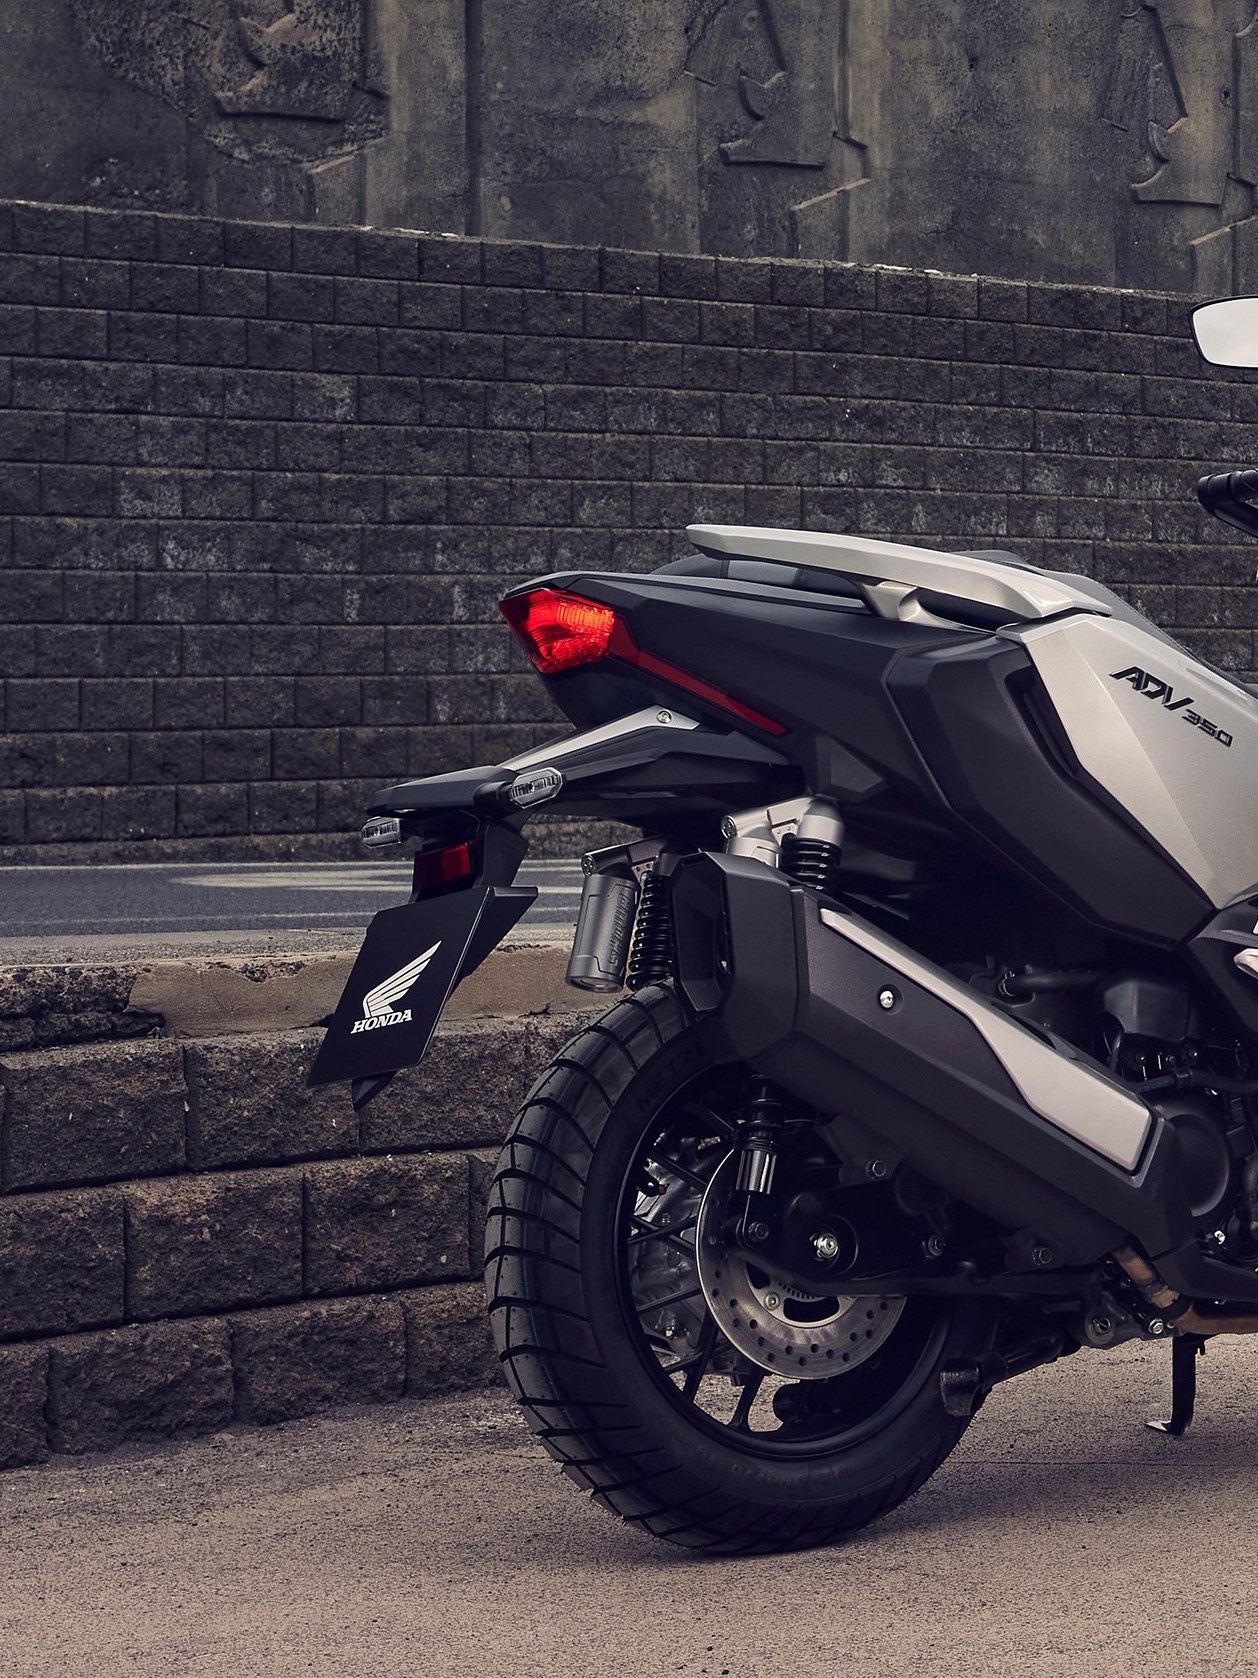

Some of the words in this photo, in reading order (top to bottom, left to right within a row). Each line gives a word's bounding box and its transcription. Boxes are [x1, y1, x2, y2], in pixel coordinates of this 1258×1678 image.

[1109, 665, 1194, 711] ADV
[1181, 708, 1233, 748] 350
[608, 892, 630, 967] SHOWA
[351, 1010, 412, 1034] HONDA
